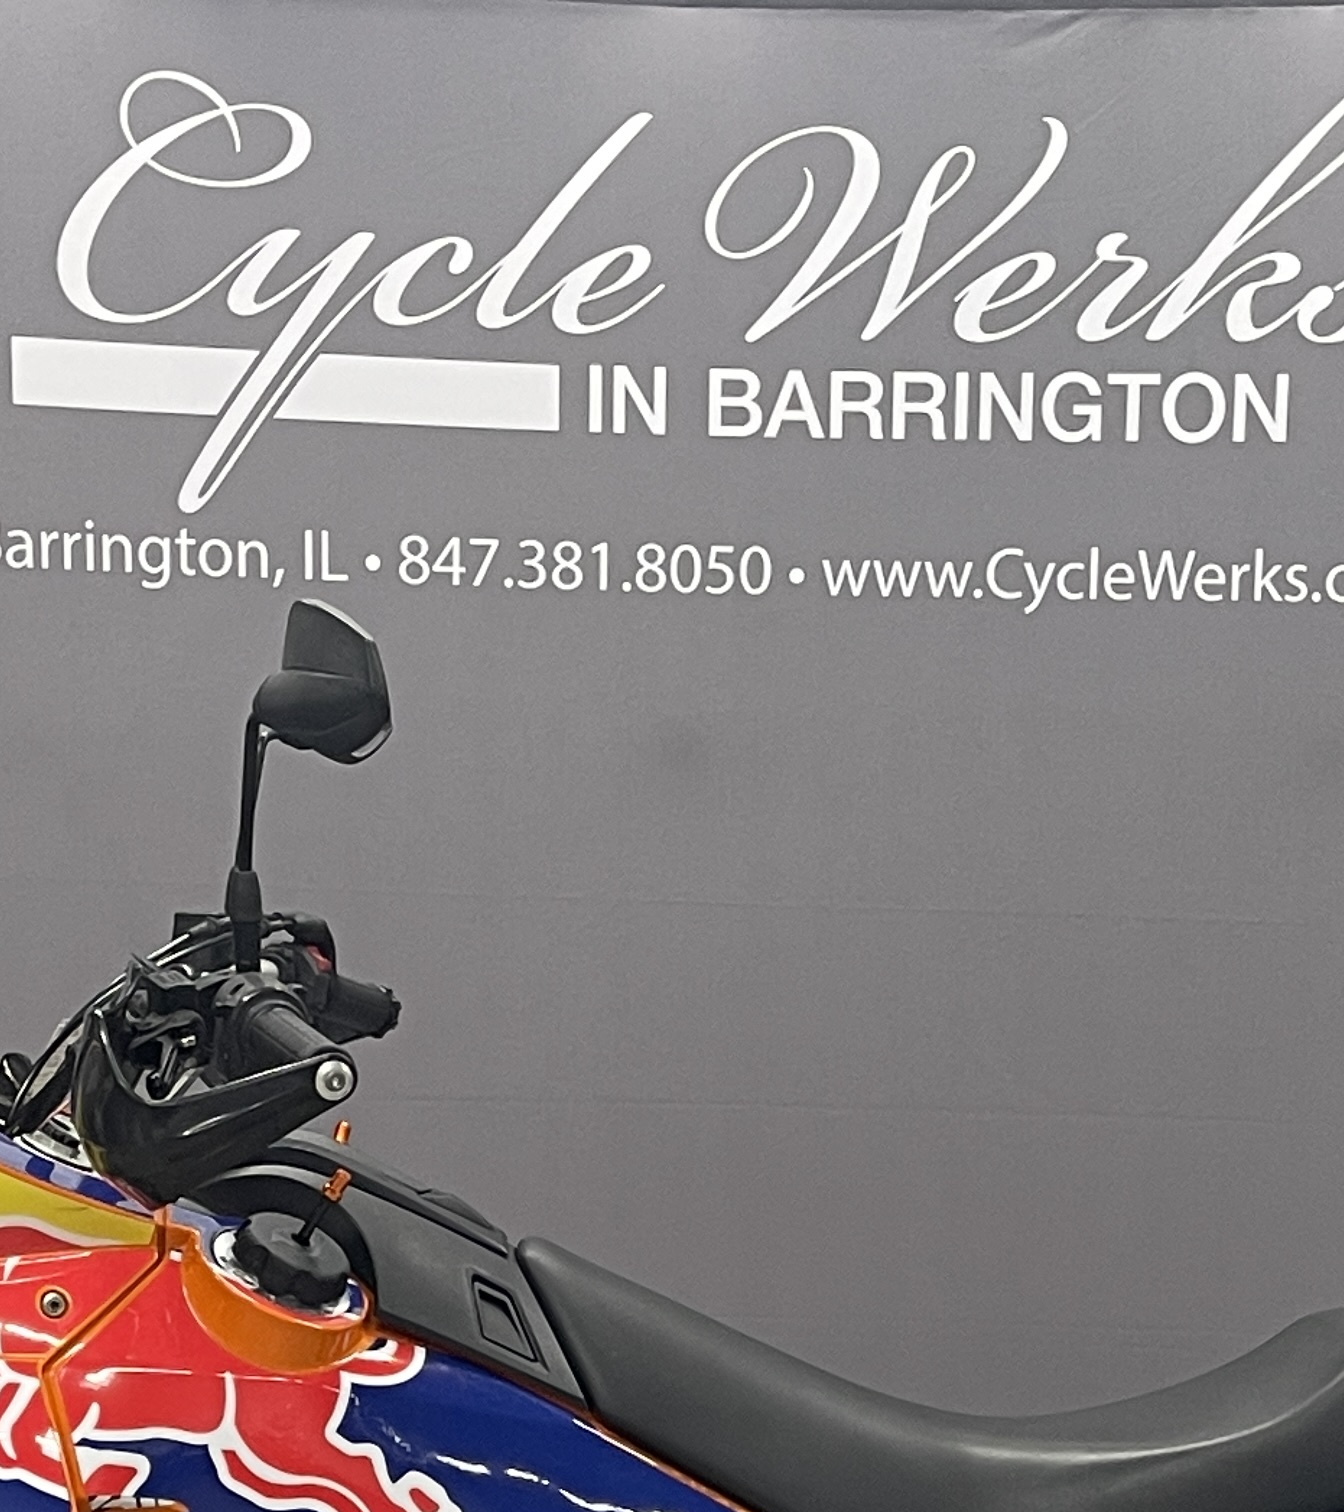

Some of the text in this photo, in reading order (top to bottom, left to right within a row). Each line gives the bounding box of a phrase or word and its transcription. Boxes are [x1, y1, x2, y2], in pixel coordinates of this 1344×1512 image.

[56, 71, 666, 513] Cycle
[590, 365, 1289, 443] IN BARRINGTON
[305, 530, 348, 581] IL
[399, 536, 771, 594] 847.381.8050
